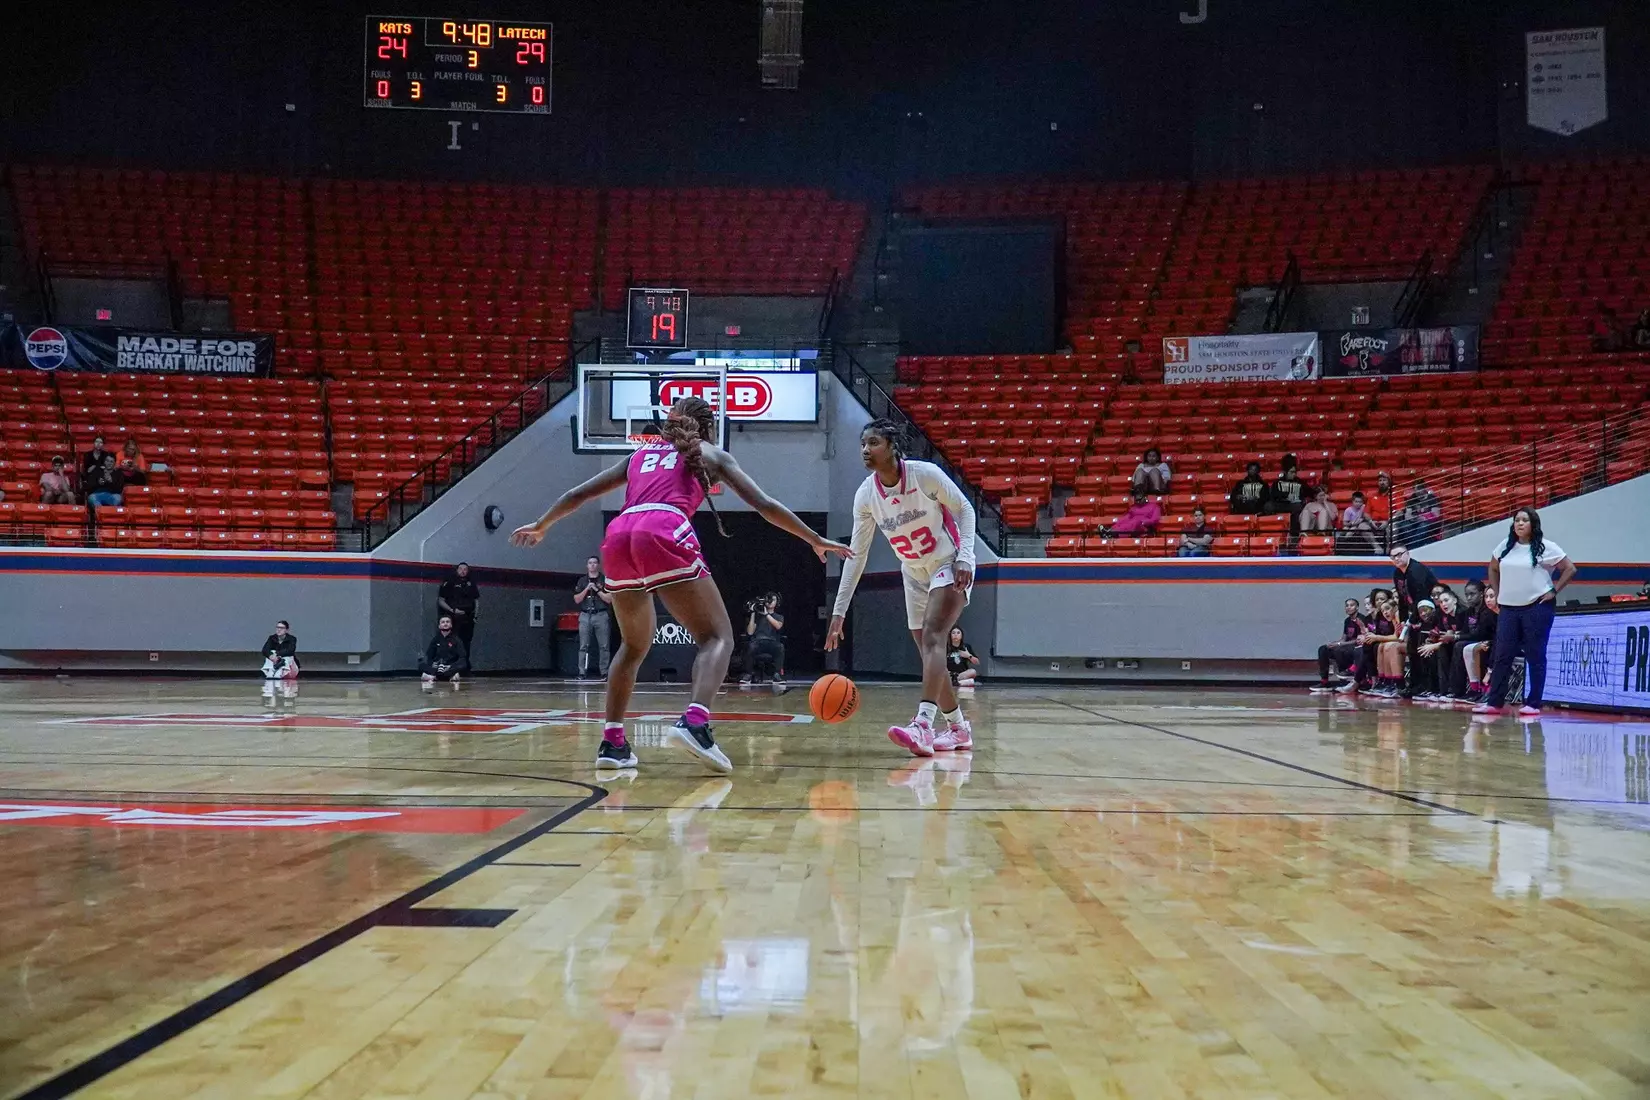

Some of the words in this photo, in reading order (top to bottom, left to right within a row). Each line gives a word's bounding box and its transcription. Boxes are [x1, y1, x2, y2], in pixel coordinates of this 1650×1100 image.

[379, 22, 412, 35] KATS
[443, 21, 491, 46] 9:48
[498, 27, 546, 40] LATECH
[378, 36, 407, 58] 24
[516, 42, 544, 64] 29
[435, 54, 463, 63] PERIOD
[468, 50, 478, 68] 3
[371, 70, 391, 79] FOULS
[434, 71, 463, 80] PLAYER
[465, 72, 484, 81] FOUL
[525, 76, 545, 85] FOULS
[377, 80, 389, 98] 0
[411, 81, 421, 99] 3
[496, 85, 507, 102] 3
[532, 86, 543, 103] 0
[451, 101, 477, 110] MATCH
[524, 104, 549, 113] SCORE
[447, 121, 462, 150] I
[651, 313, 675, 341] 19
[27, 343, 65, 354] PEPSI
[117, 335, 197, 354] MADE
[201, 339, 256, 357] FOR
[117, 351, 183, 371] BEARKAT
[185, 354, 256, 373] WATCHING
[1164, 365, 1202, 375] PROUD
[1205, 362, 1259, 373] SPONSOR
[1262, 361, 1278, 371] OF
[669, 386, 758, 406] H-E-B
[640, 451, 679, 474] 24
[889, 525, 937, 560] 23
[1561, 636, 1611, 664] MEMORIAL
[1623, 625, 1650, 693] PR
[1559, 662, 1609, 687] HERMANN
[839, 686, 860, 718] Wilson
